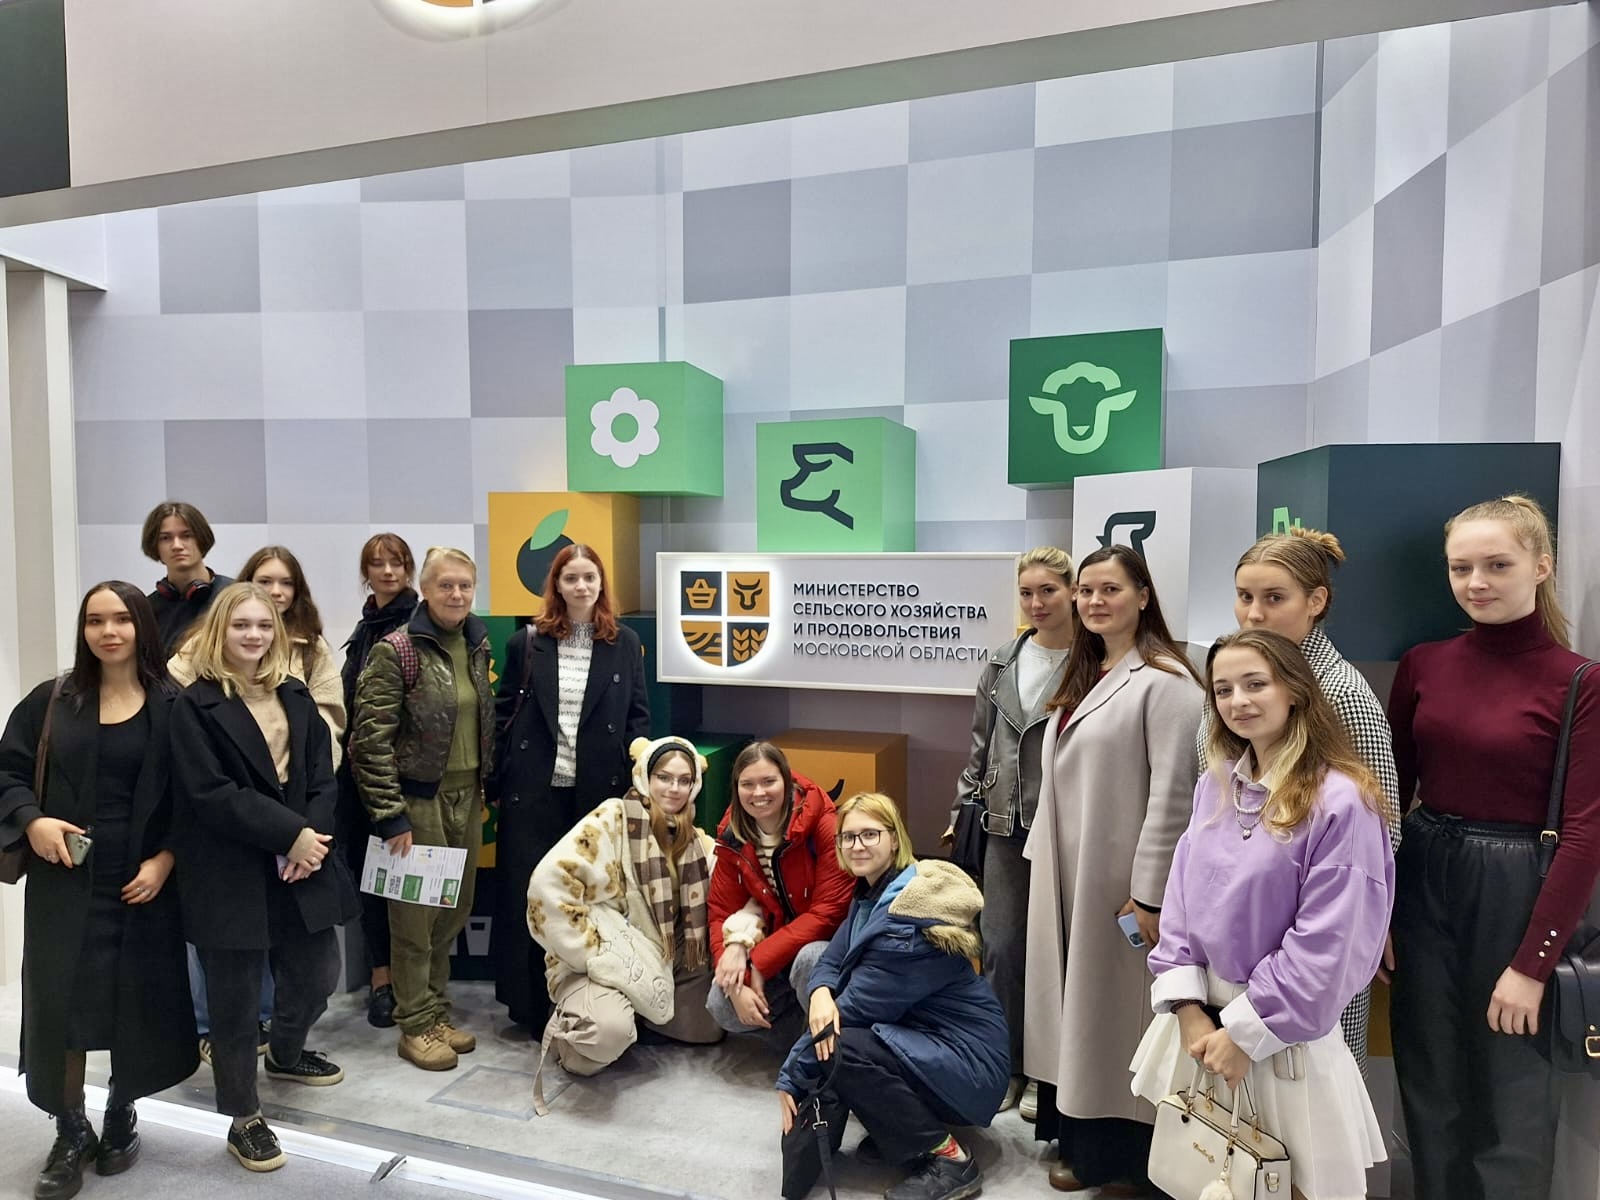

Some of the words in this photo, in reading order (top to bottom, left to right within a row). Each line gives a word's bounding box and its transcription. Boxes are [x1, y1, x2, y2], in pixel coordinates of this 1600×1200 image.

[793, 583, 919, 598] МИНИСТЕРСТВО
[793, 602, 886, 617] СЕЛЬСКОГО
[890, 602, 987, 619] ХОЗЯЙСТВА
[793, 623, 803, 636] И
[807, 624, 960, 640] ПРОДОВОЛЬСТВИЯ
[793, 642, 904, 659] МОСКОВСКОЙ
[909, 645, 988, 662] ОБЛАСТИ
